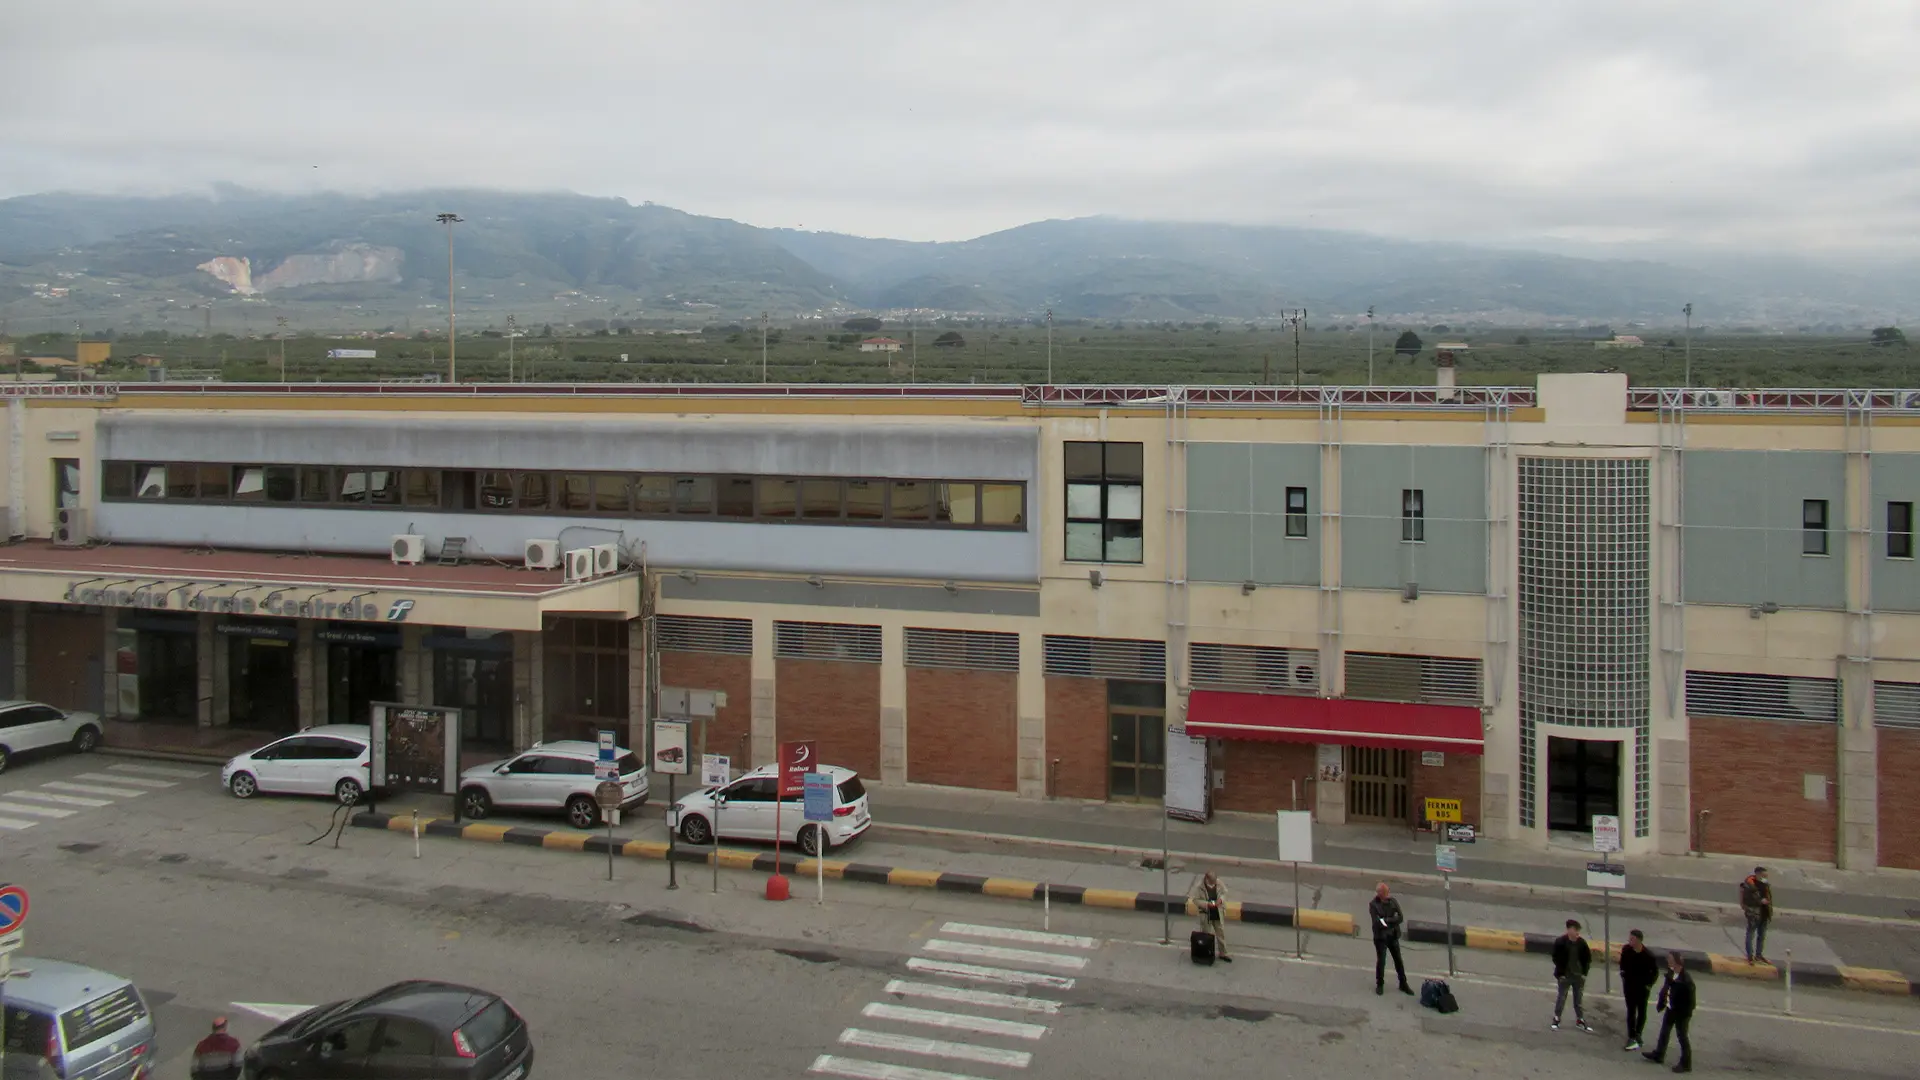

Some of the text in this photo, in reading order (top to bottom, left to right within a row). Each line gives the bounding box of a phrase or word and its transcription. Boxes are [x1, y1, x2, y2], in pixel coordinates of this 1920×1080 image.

[177, 587, 257, 614] Terme
[266, 591, 379, 620] Centrale
[1427, 801, 1459, 810] FERMATA
[1435, 810, 1451, 818] BUS
